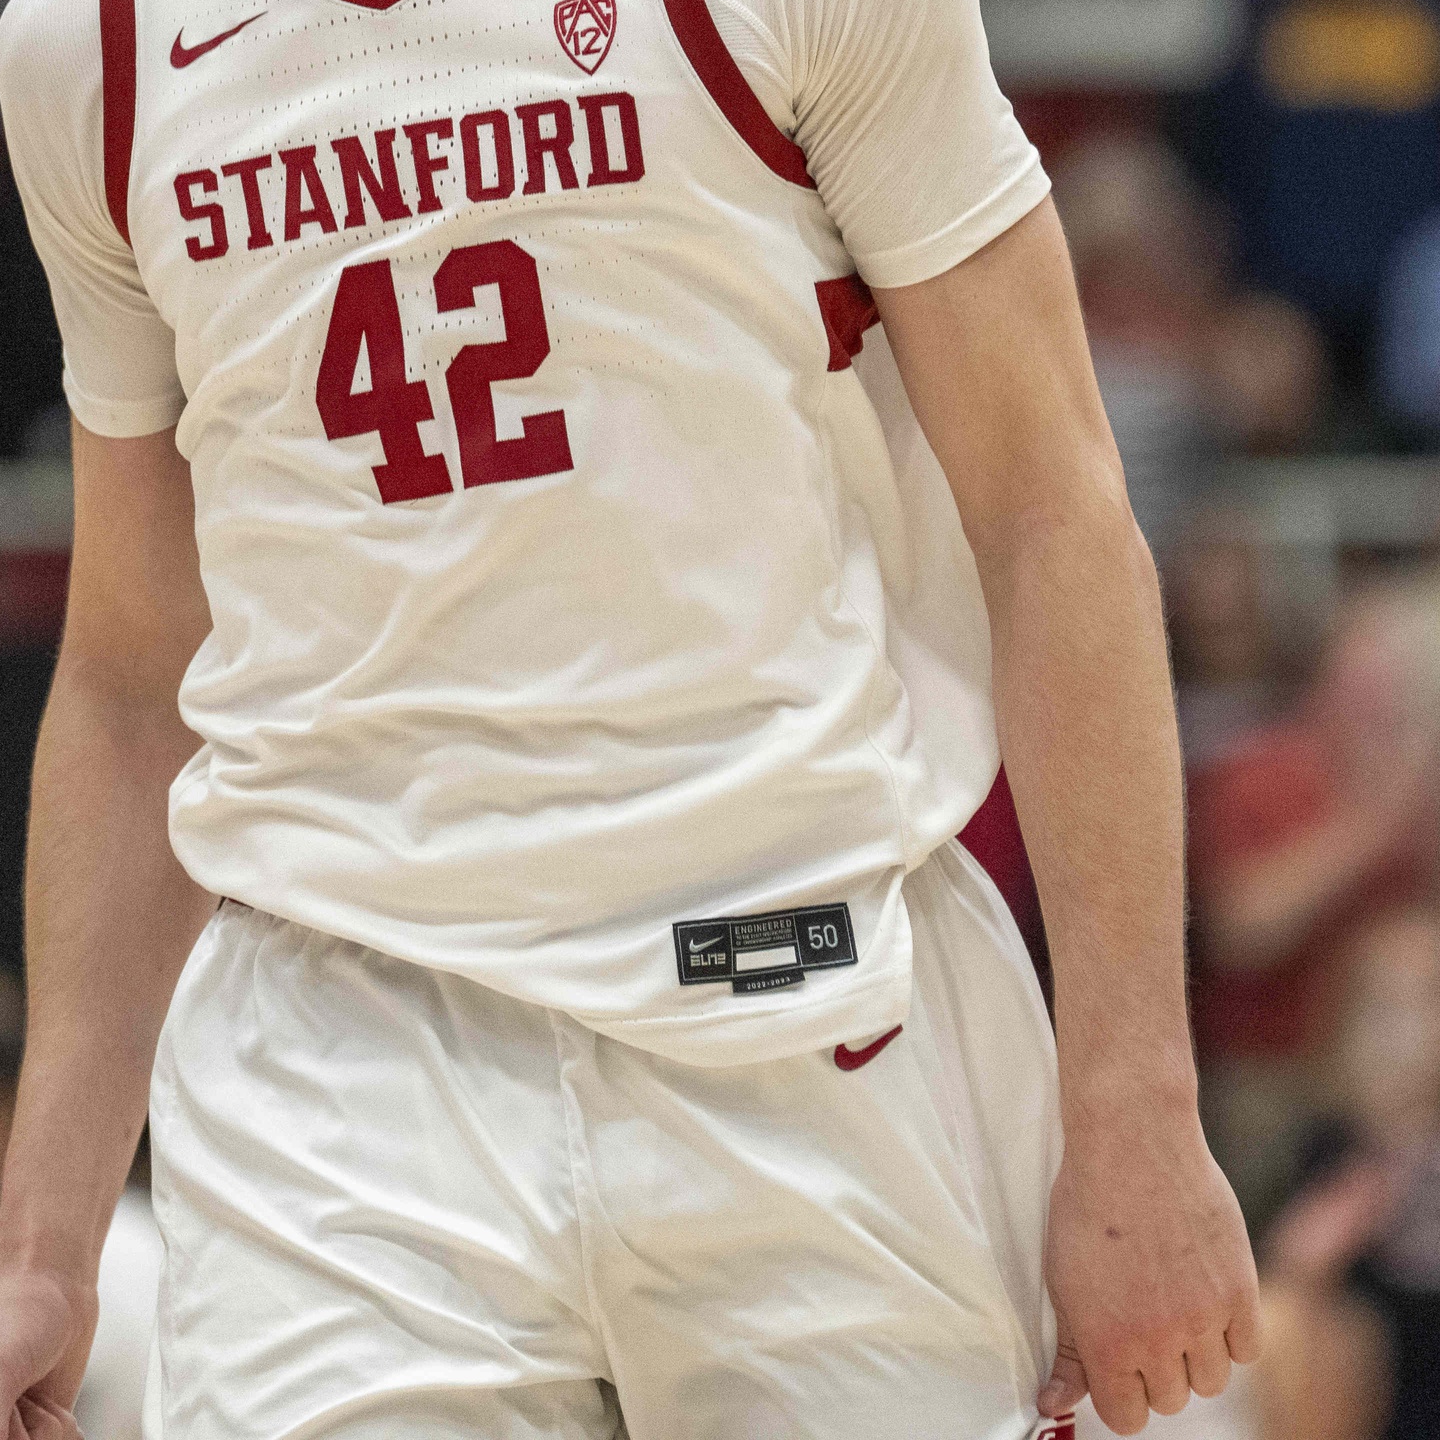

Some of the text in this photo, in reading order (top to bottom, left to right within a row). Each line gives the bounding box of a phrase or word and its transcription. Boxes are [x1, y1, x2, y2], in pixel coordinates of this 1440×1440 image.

[572, 26, 602, 56] 12
[173, 91, 646, 262] STANFORD
[316, 239, 574, 505] 42
[734, 919, 792, 935] ENGINEERED
[808, 924, 839, 950] 50
